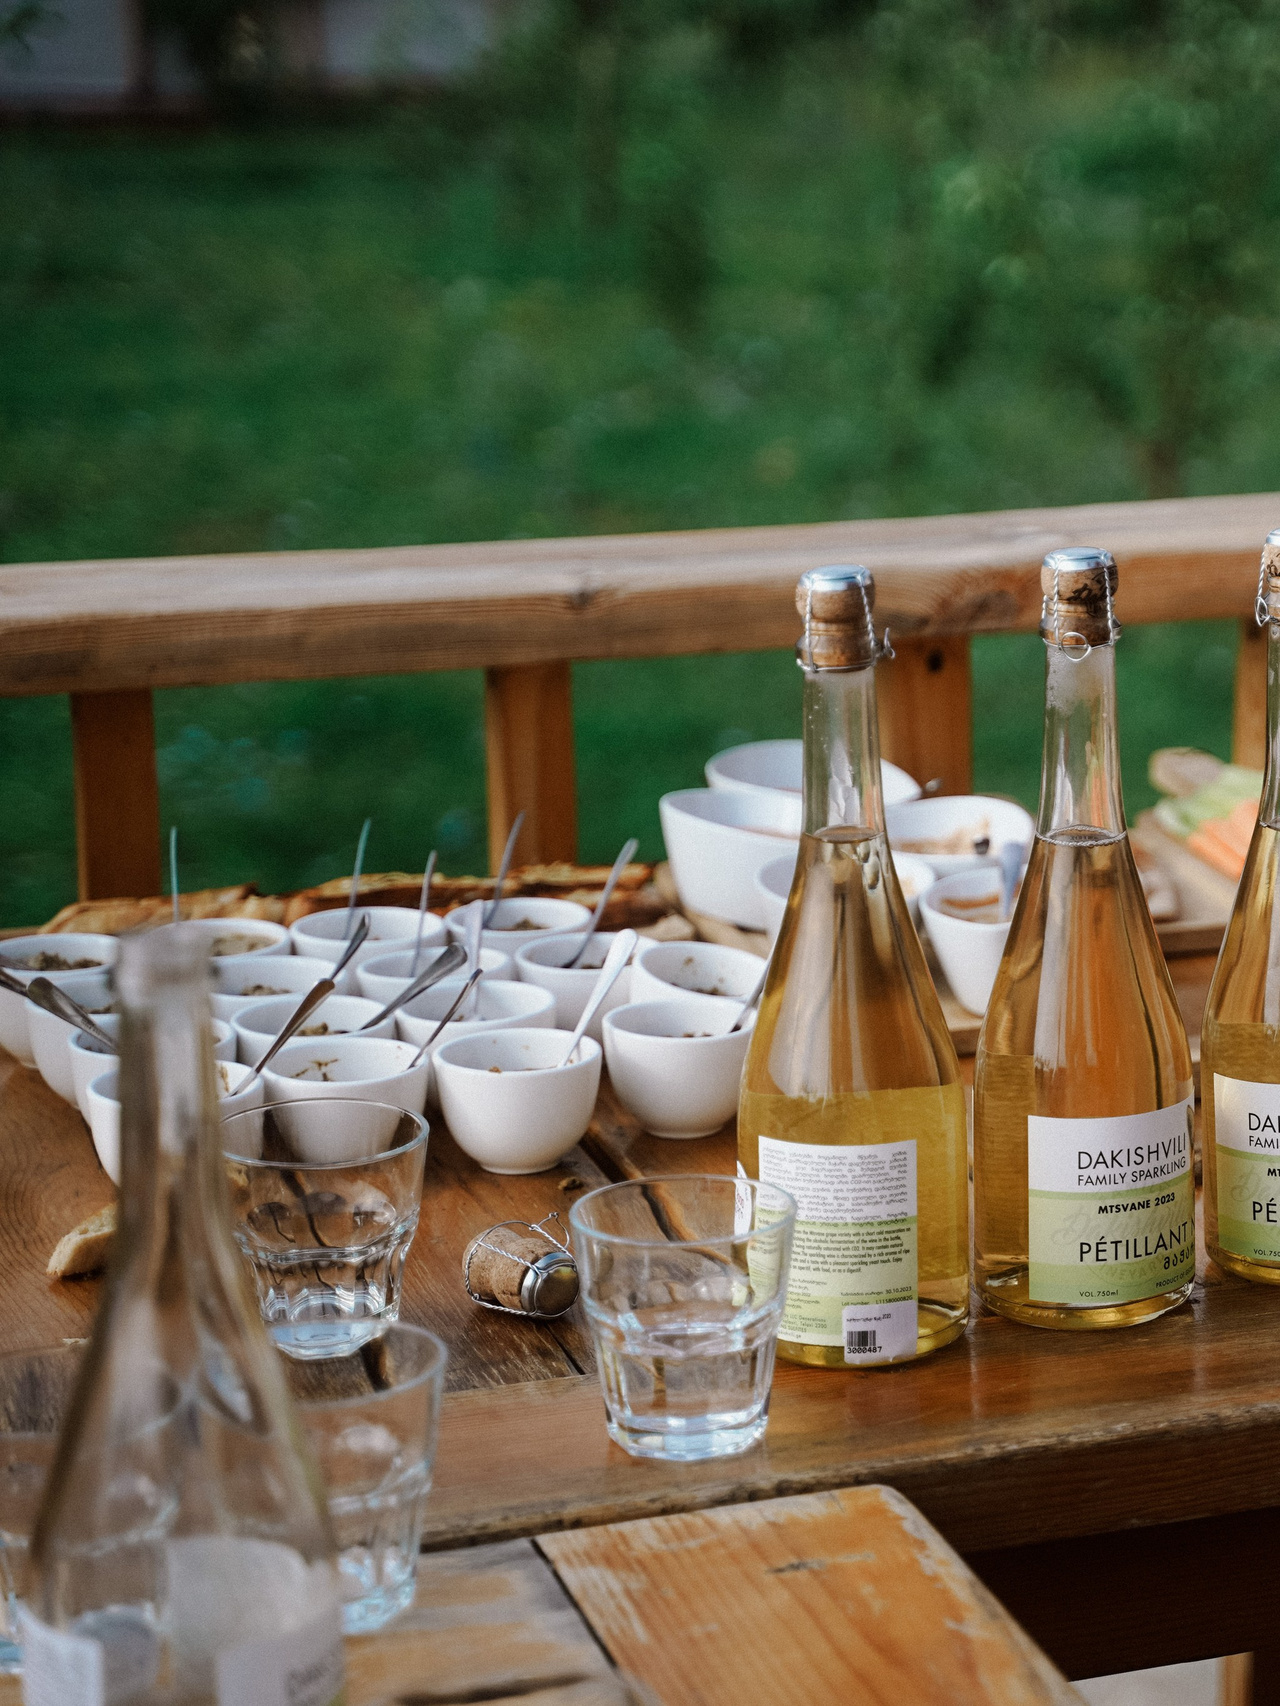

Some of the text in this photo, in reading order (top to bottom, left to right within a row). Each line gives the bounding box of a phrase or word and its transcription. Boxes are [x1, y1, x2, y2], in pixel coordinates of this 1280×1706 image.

[1078, 1132, 1186, 1170] DAKISHVILI
[1078, 1156, 1186, 1186] FAMILY SPARKLING
[1097, 1192, 1175, 1215] MTSVANE 2023
[1079, 1220, 1188, 1263] PÉTILLANT
[886, 1286, 912, 1295] 30.10.2023
[1155, 1275, 1179, 1289] PRODUCT
[847, 1346, 882, 1354] 3000487
